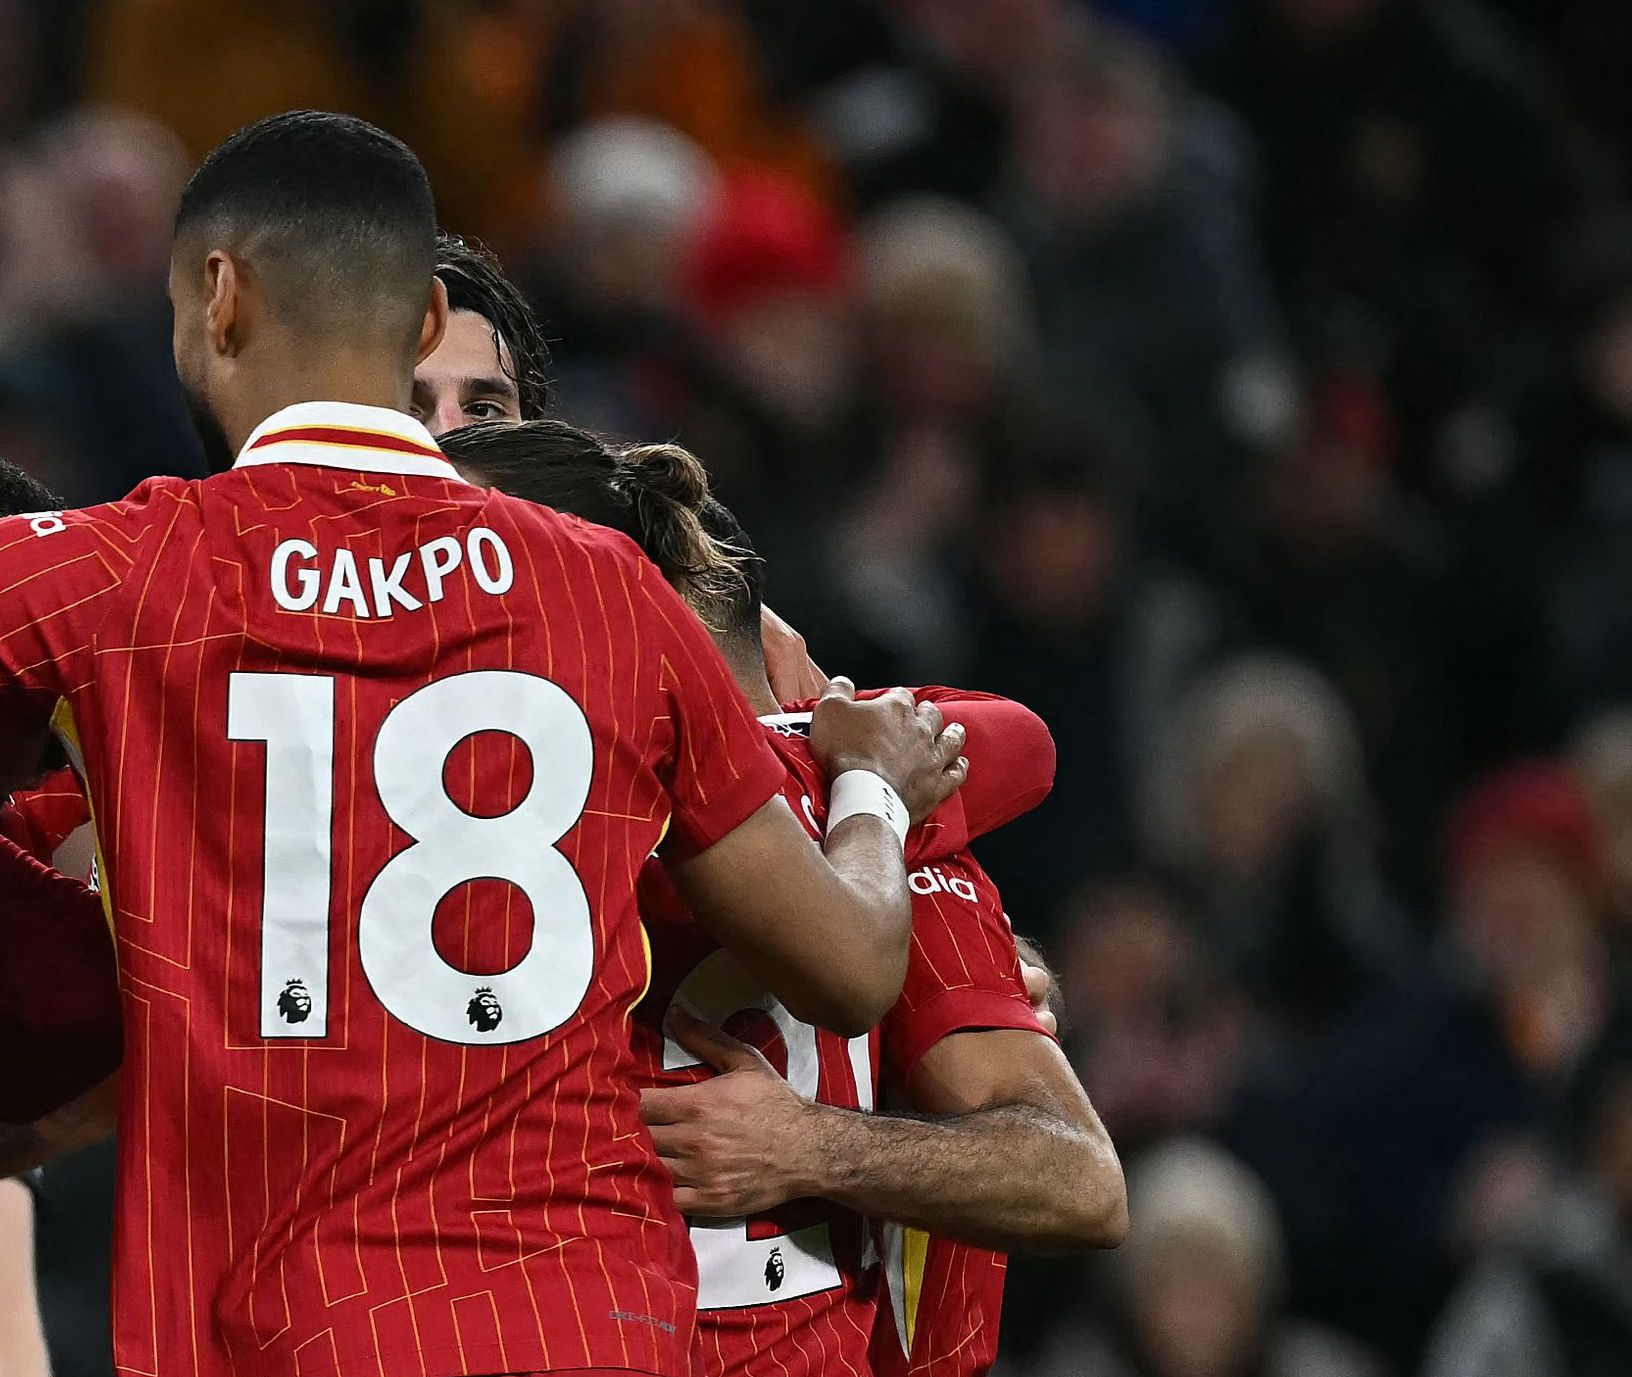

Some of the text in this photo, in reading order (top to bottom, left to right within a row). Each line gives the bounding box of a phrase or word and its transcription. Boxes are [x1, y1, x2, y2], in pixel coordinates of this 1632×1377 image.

[270, 526, 515, 619] GAKPO
[227, 669, 595, 1046] 18
[907, 866, 979, 903] dia
